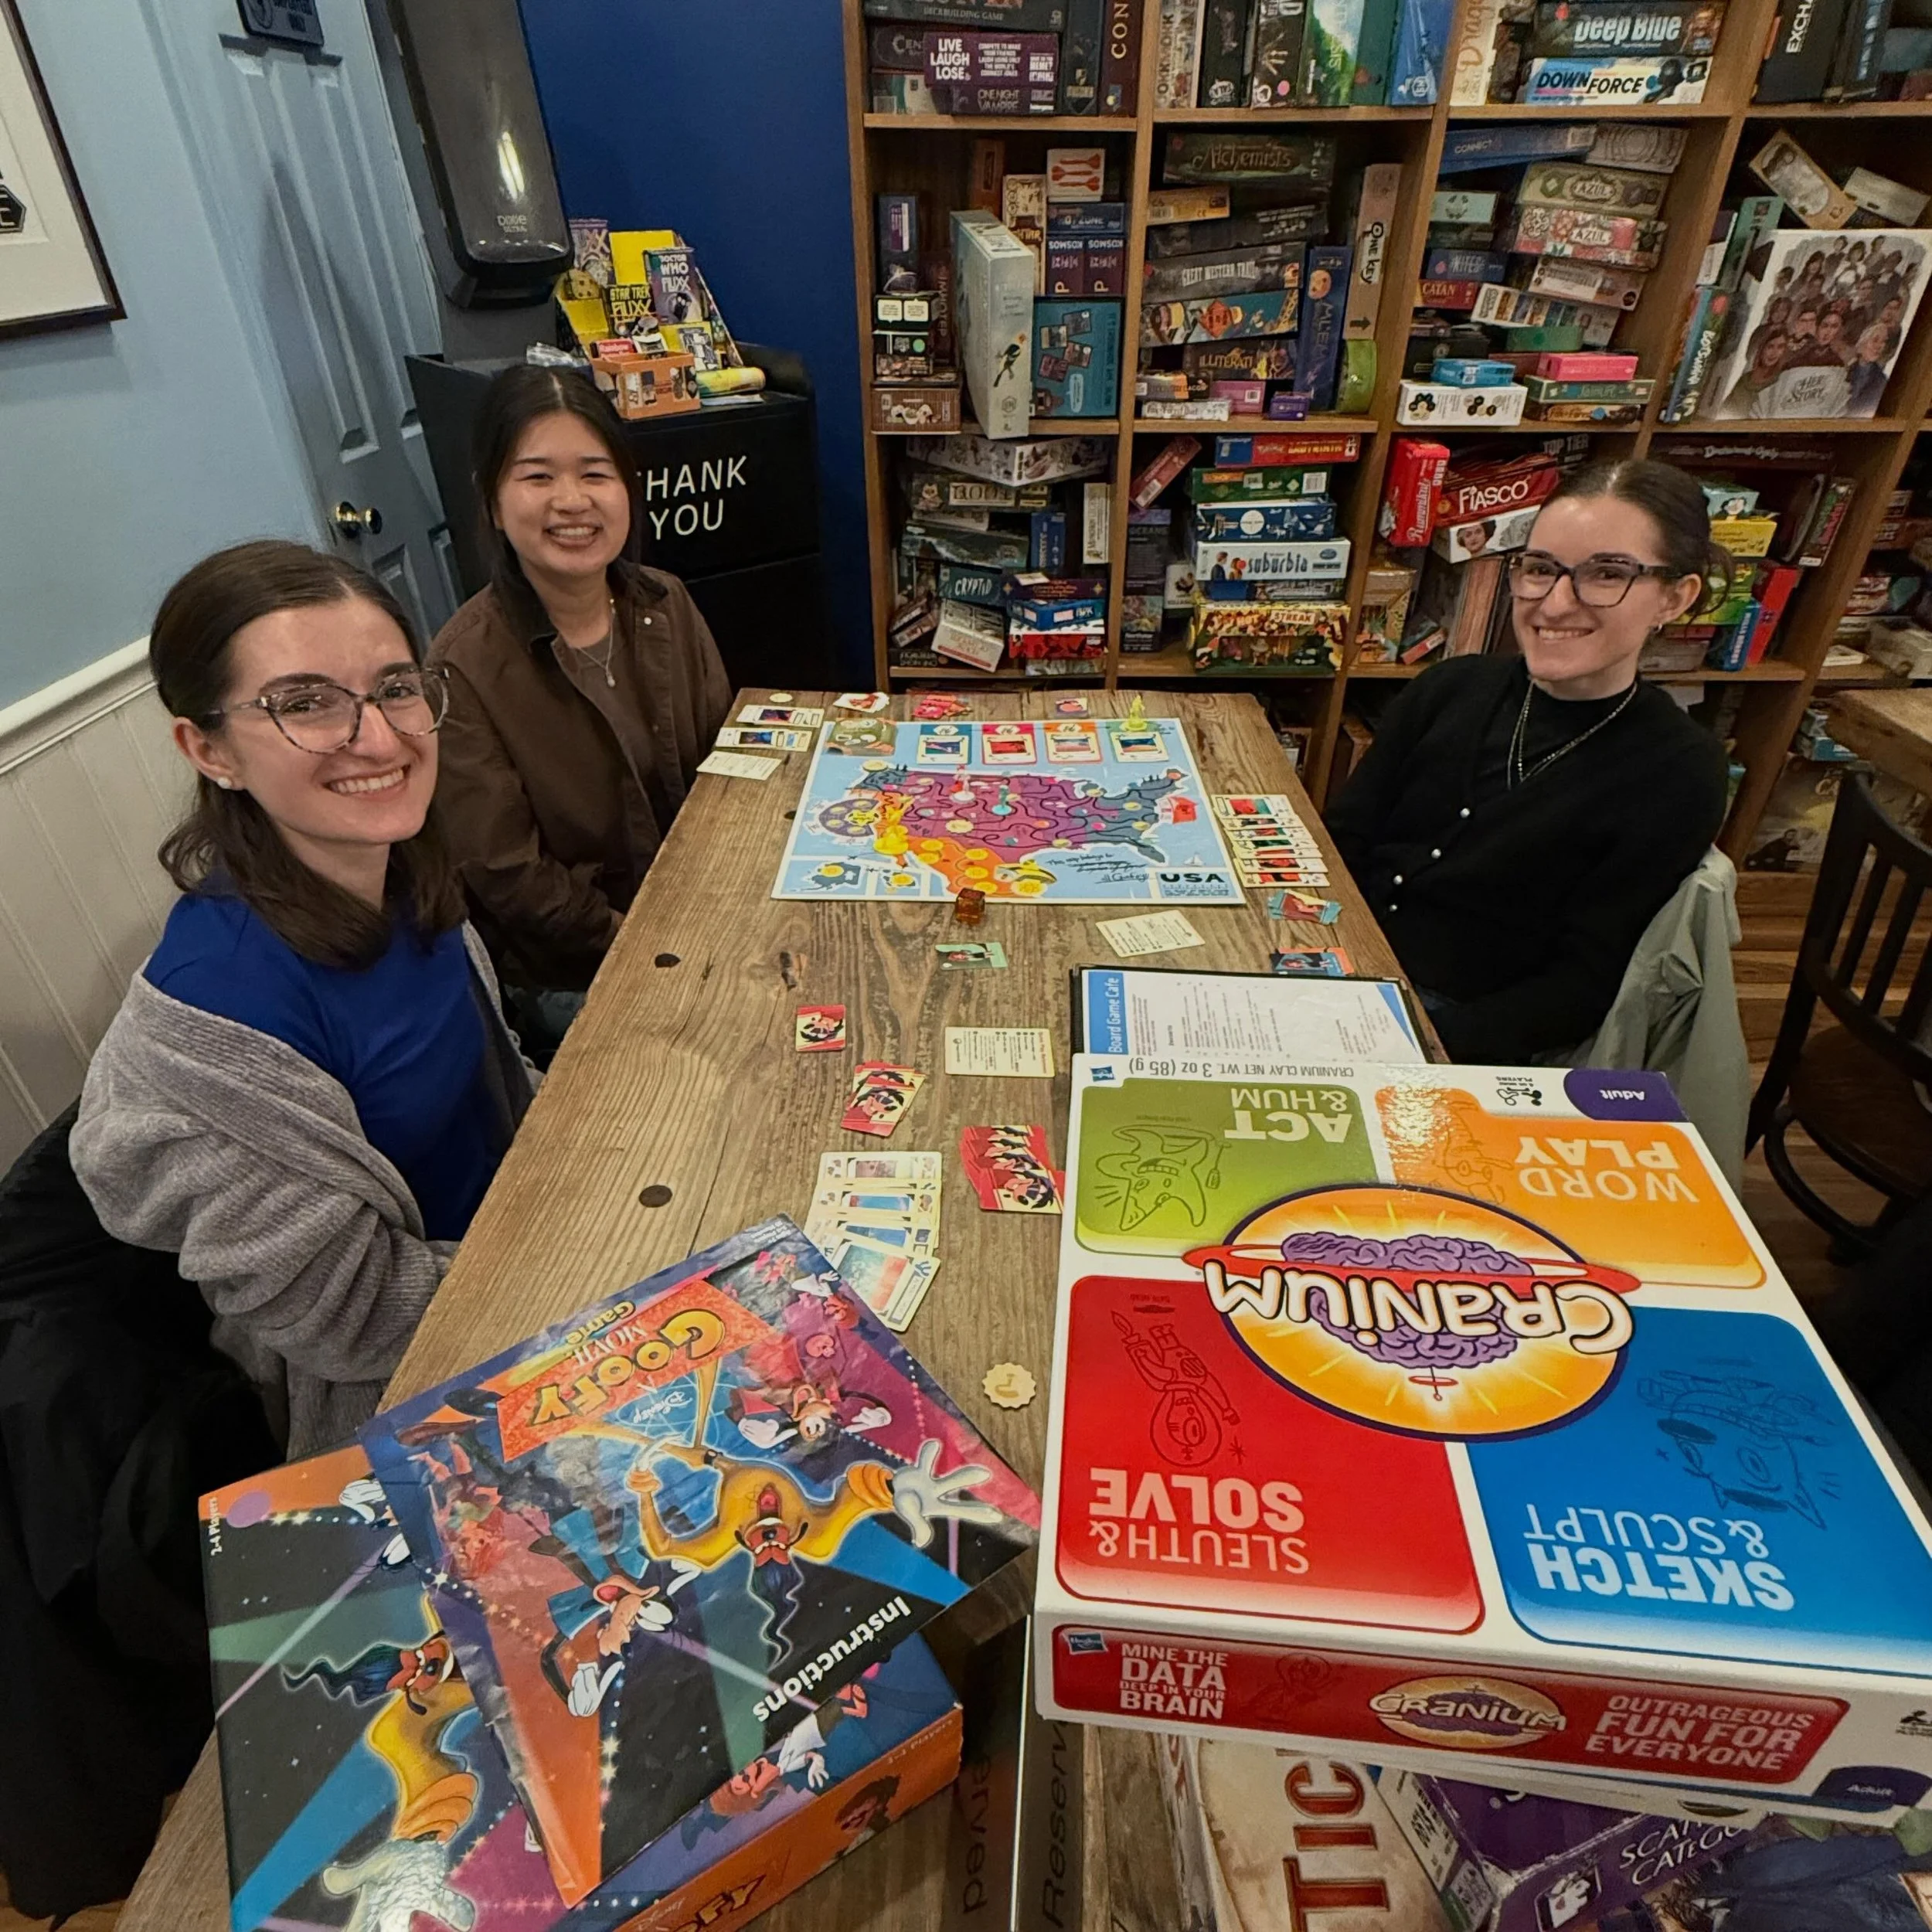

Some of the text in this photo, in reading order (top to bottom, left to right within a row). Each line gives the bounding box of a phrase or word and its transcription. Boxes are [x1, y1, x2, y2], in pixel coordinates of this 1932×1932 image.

[981, 11, 1004, 21] GAME
[1574, 15, 1682, 46] Deep Blue
[930, 53, 970, 66] LAUGH
[938, 39, 963, 52] LIVE
[1536, 71, 1645, 94] DOWN FORCE
[1192, 141, 1292, 172] Alchemists
[660, 253, 686, 263] DOCTOR
[1049, 240, 1083, 250] KOSMOS
[1087, 239, 1123, 249] KOSMOS
[660, 262, 689, 276] WHO
[1204, 264, 1236, 281] WESTERN
[610, 285, 651, 301] STAR TREK
[1422, 284, 1456, 296] CATAN
[637, 455, 747, 501] HANK
[649, 498, 723, 540] YOU
[1247, 552, 1308, 574] suburbia
[1274, 611, 1313, 624] STREAK
[1160, 872, 1226, 884] USA
[1108, 995, 1123, 1023] Game
[1108, 1023, 1123, 1054] Board
[1128, 1057, 1355, 1078] CRANIUM CLAY NET WT. 3 oz (85 g)
[1230, 1087, 1349, 1112] & HUM
[1599, 1089, 1646, 1101] Adult
[1224, 1110, 1354, 1144] ACT
[1514, 1137, 1680, 1170] PLAY
[1519, 1165, 1700, 1202] WORD
[566, 1300, 637, 1345] Game
[529, 1308, 726, 1427] GOOFY
[1089, 1467, 1306, 1534] SOLVE
[1089, 1519, 1310, 1574] & SLEUTH
[1523, 1503, 1770, 1559] & SCULPT
[1526, 1543, 1795, 1611] SKETCH
[752, 1596, 912, 1723] Instructions
[1121, 1643, 1230, 1668] MINE THE
[1121, 1658, 1226, 1691] DATA
[1119, 1681, 1226, 1700] DEEP IN YOUR
[1119, 1689, 1224, 1719] BRAIN
[1607, 1695, 1815, 1729] OUTRAGEOUS
[1595, 1711, 1803, 1753] FUN FOR
[1585, 1733, 1791, 1770] EVERYONE
[1042, 1722, 1070, 1929] Reserv
[1277, 1757, 1389, 1932] TIC
[1631, 1824, 1745, 1886] CATEGO
